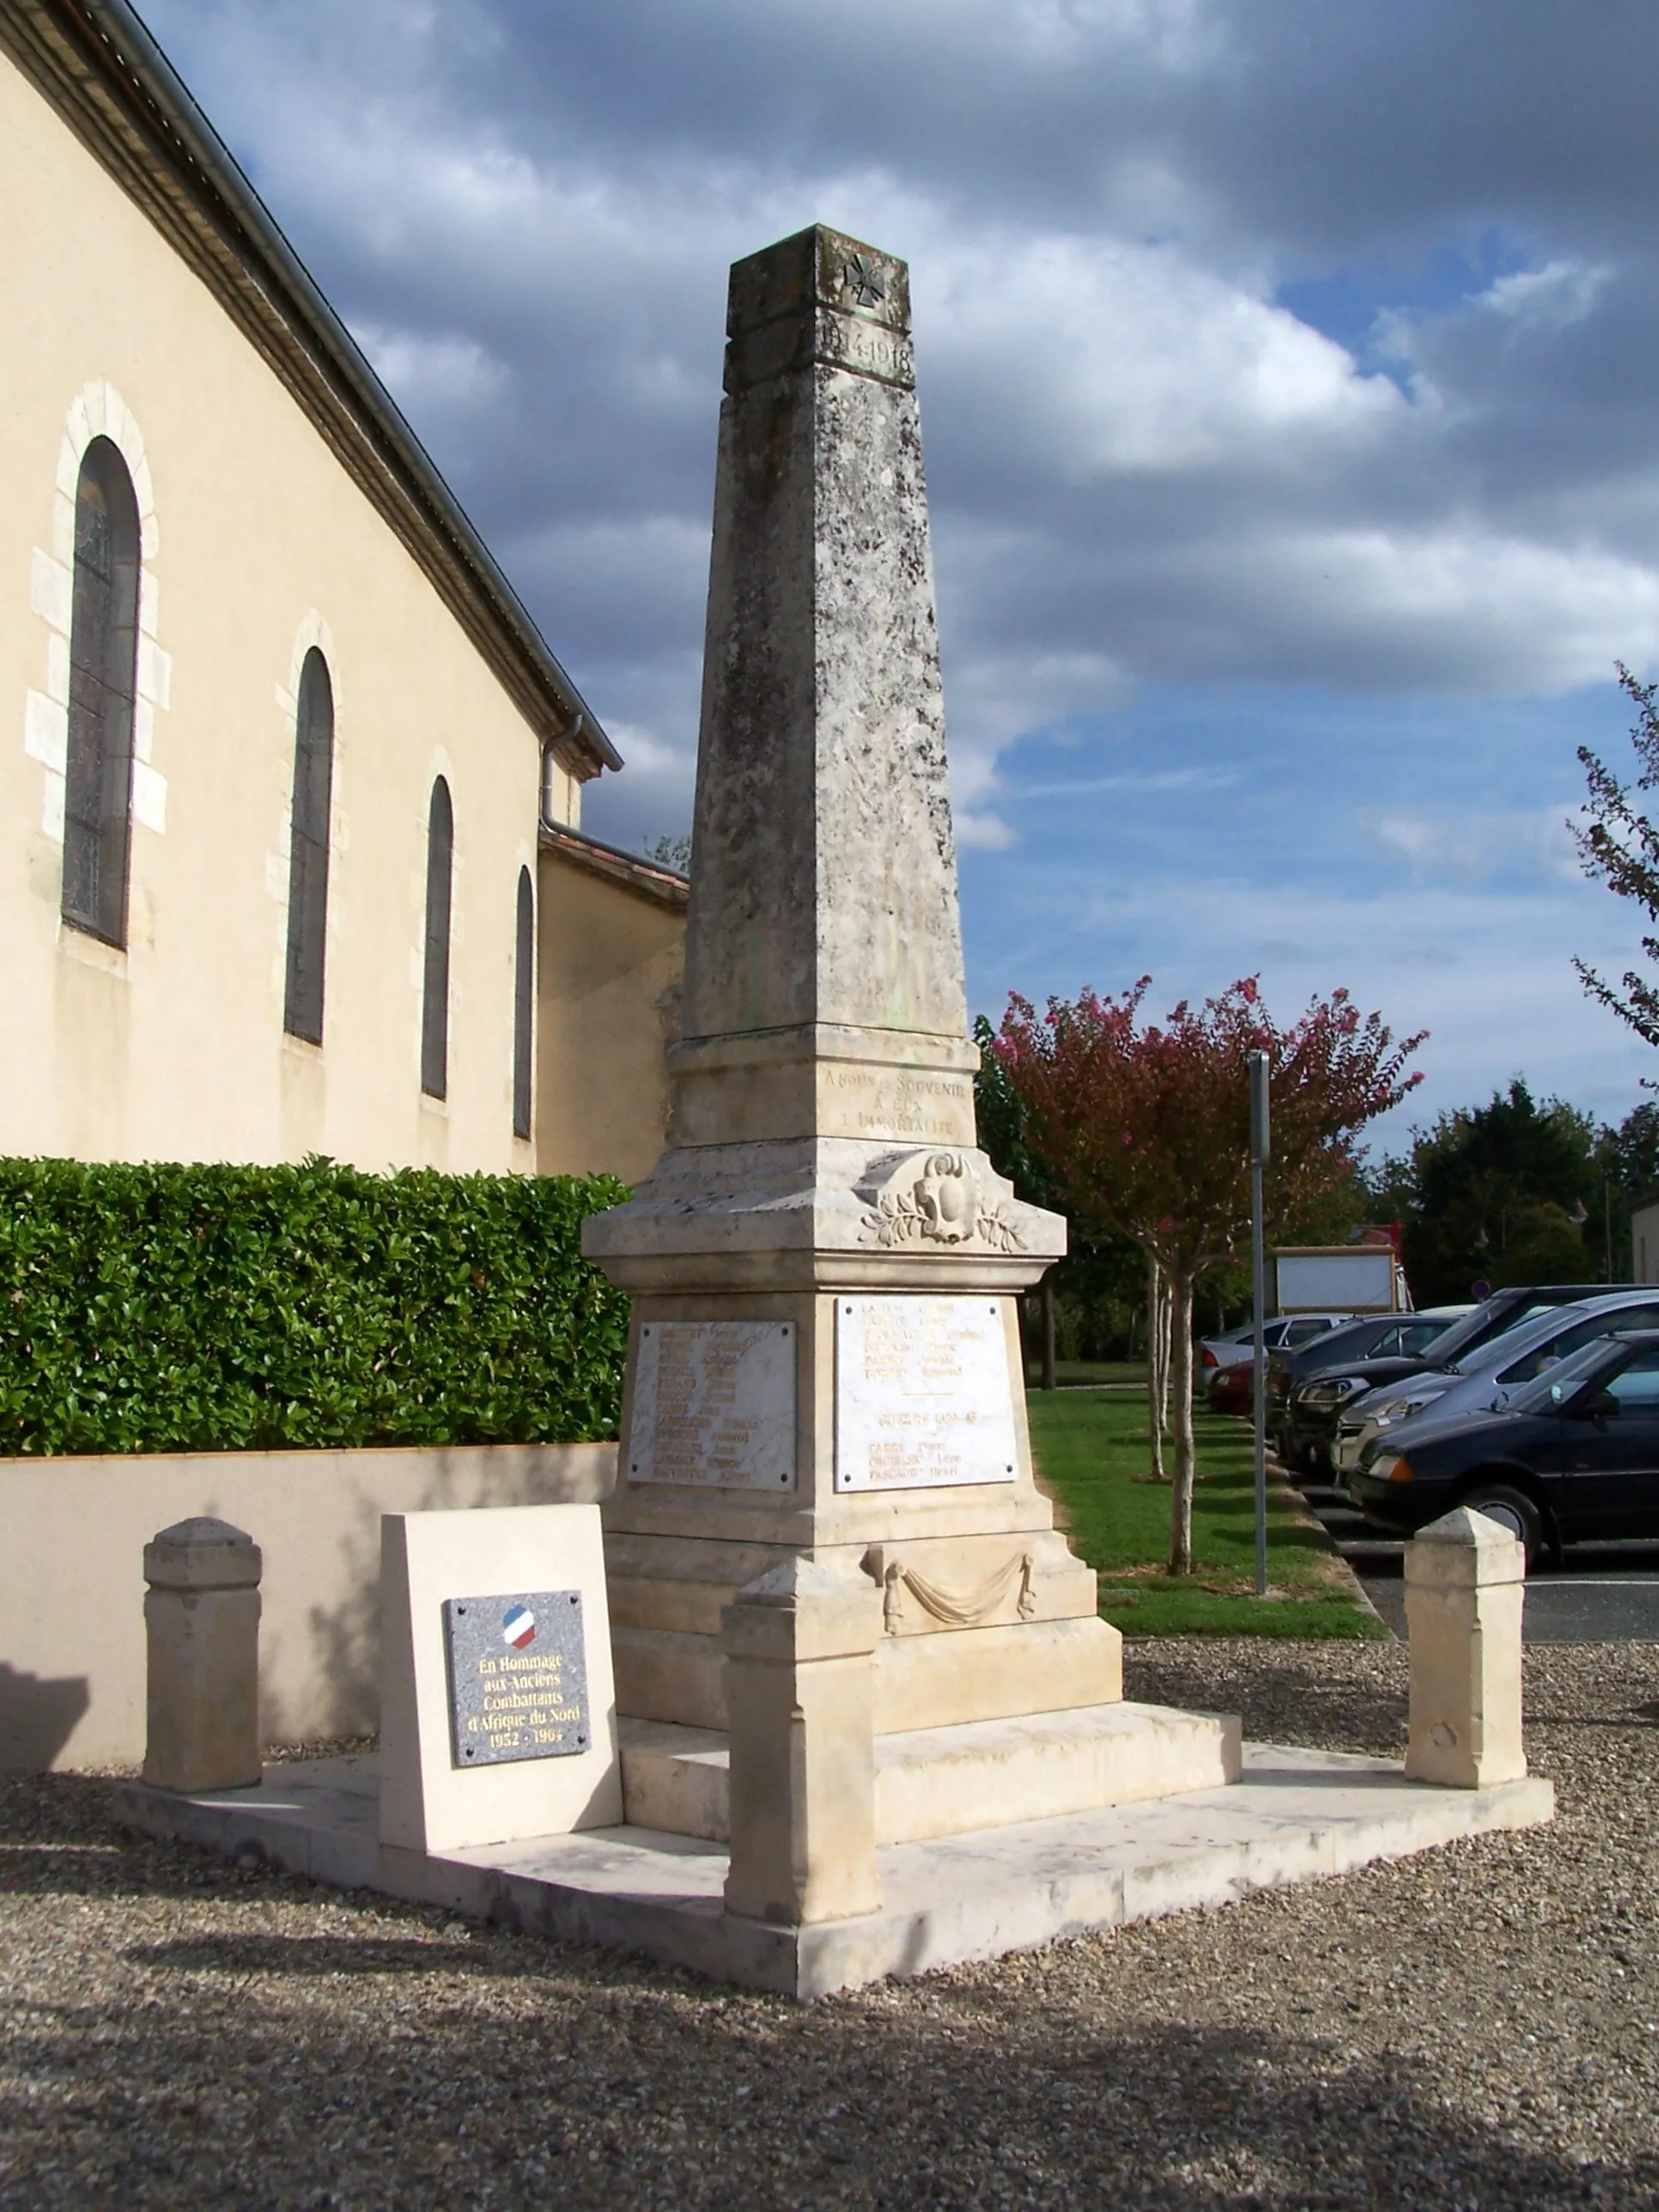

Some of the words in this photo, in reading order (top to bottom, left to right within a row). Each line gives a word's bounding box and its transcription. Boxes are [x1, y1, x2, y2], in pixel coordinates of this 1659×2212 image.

[838, 1073, 875, 1089] NOUS
[897, 1075, 965, 1097] SOUVENIR
[479, 1658, 497, 1674] En
[500, 1655, 563, 1672] Hommage
[483, 1678, 507, 1692] aux
[512, 1673, 562, 1690] Anciens
[483, 1692, 564, 1711] Combattants
[468, 1713, 526, 1731] d'Afrique
[530, 1709, 547, 1725] du
[550, 1705, 581, 1723] Nord
[490, 1732, 520, 1748] 1952
[534, 1728, 564, 1744] 1964
